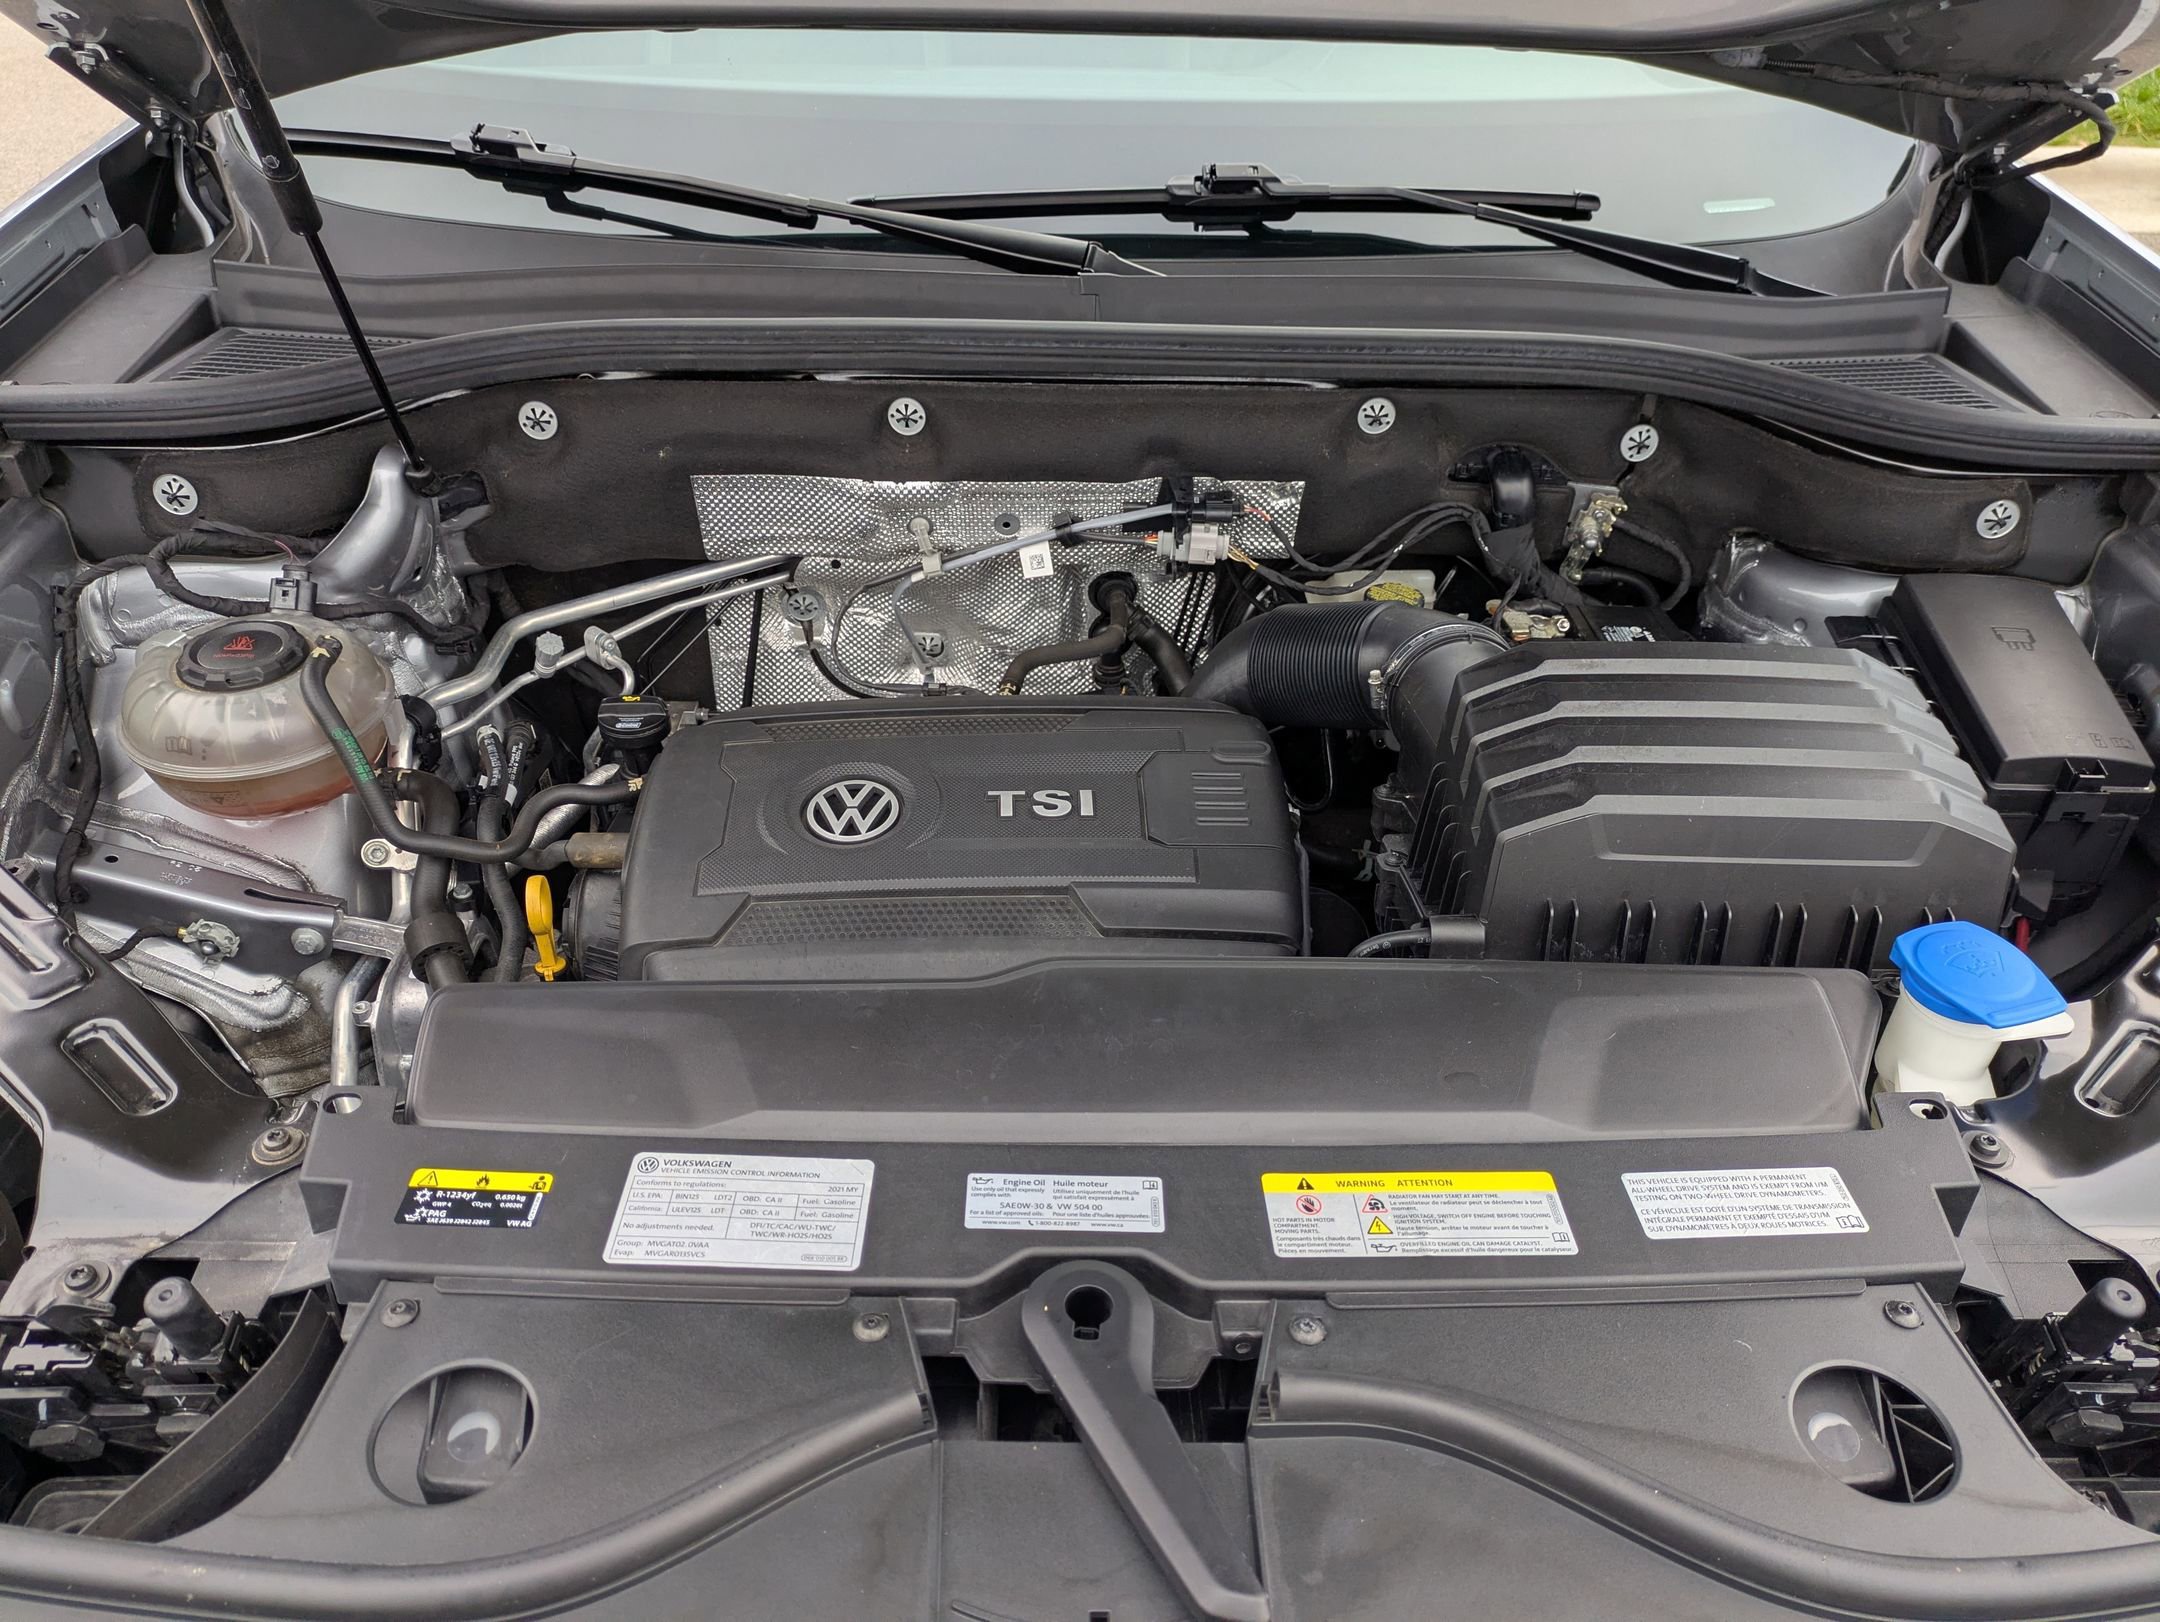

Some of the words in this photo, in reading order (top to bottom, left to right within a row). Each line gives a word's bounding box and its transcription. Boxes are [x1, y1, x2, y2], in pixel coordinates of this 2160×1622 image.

[988, 789, 1094, 817] TSI
[663, 1159, 732, 1168] VOLKSWAGEN
[767, 1170, 821, 1179] INFORMATION
[683, 1180, 726, 1189] regulations:
[1003, 1179, 1032, 1187] Engine
[1397, 1179, 1453, 1187] ATTENTION
[1690, 1176, 1728, 1184] EQUIPPED
[436, 1191, 476, 1200] R-1234yf
[823, 1198, 856, 1206] Gasoline
[628, 1204, 662, 1212] California:
[671, 1206, 701, 1214] ULEV125
[821, 1211, 854, 1219] Gasoline
[1651, 1207, 1689, 1215] VÉHICULE
[1705, 1205, 1727, 1213] DOTÉ
[1795, 1202, 1851, 1210] TRANSMISSION
[1644, 1216, 1685, 1224] INTÉGRALE
[1744, 1212, 1777, 1220] EXEMPTÉ
[636, 1222, 683, 1231] adjustments
[685, 1223, 715, 1231] needed.
[617, 1240, 642, 1249] Group:
[614, 1249, 634, 1258] Evap:
